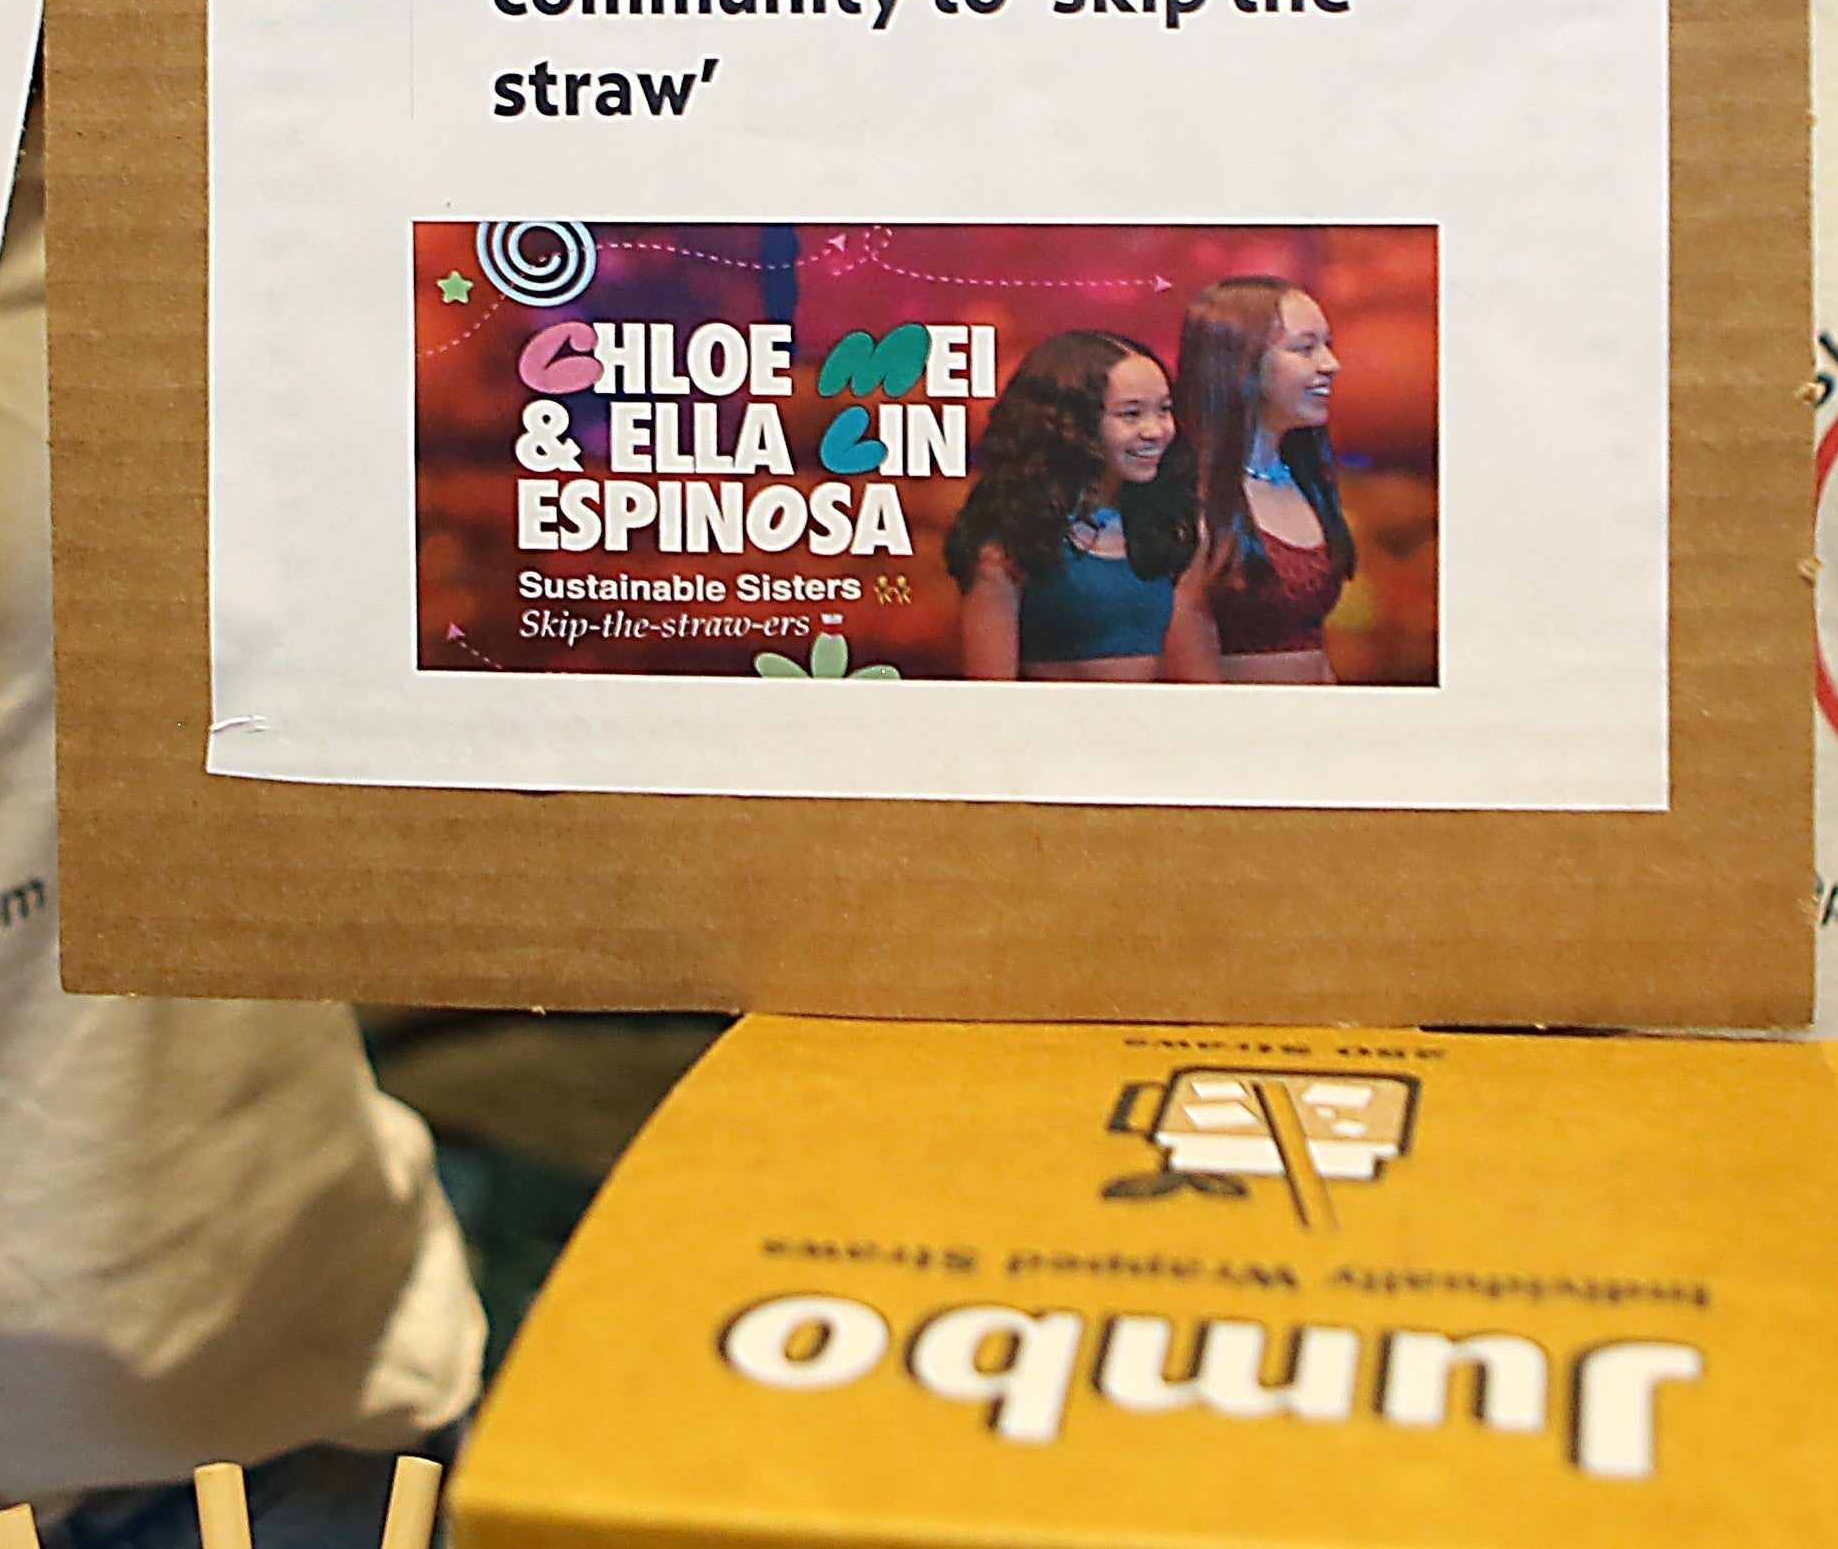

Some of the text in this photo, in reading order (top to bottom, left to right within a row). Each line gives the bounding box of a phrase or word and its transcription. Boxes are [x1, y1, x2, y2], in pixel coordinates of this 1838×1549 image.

[493, 58, 720, 118] straw’
[518, 321, 997, 398] CHLOE MEI
[515, 399, 967, 477] & ELLA LIN
[517, 478, 913, 556] ESPINOSA
[518, 570, 863, 602] Sustainable Sisters
[518, 609, 810, 647] Skip-the-straw-ers
[718, 1291, 1706, 1482] Jumbo
